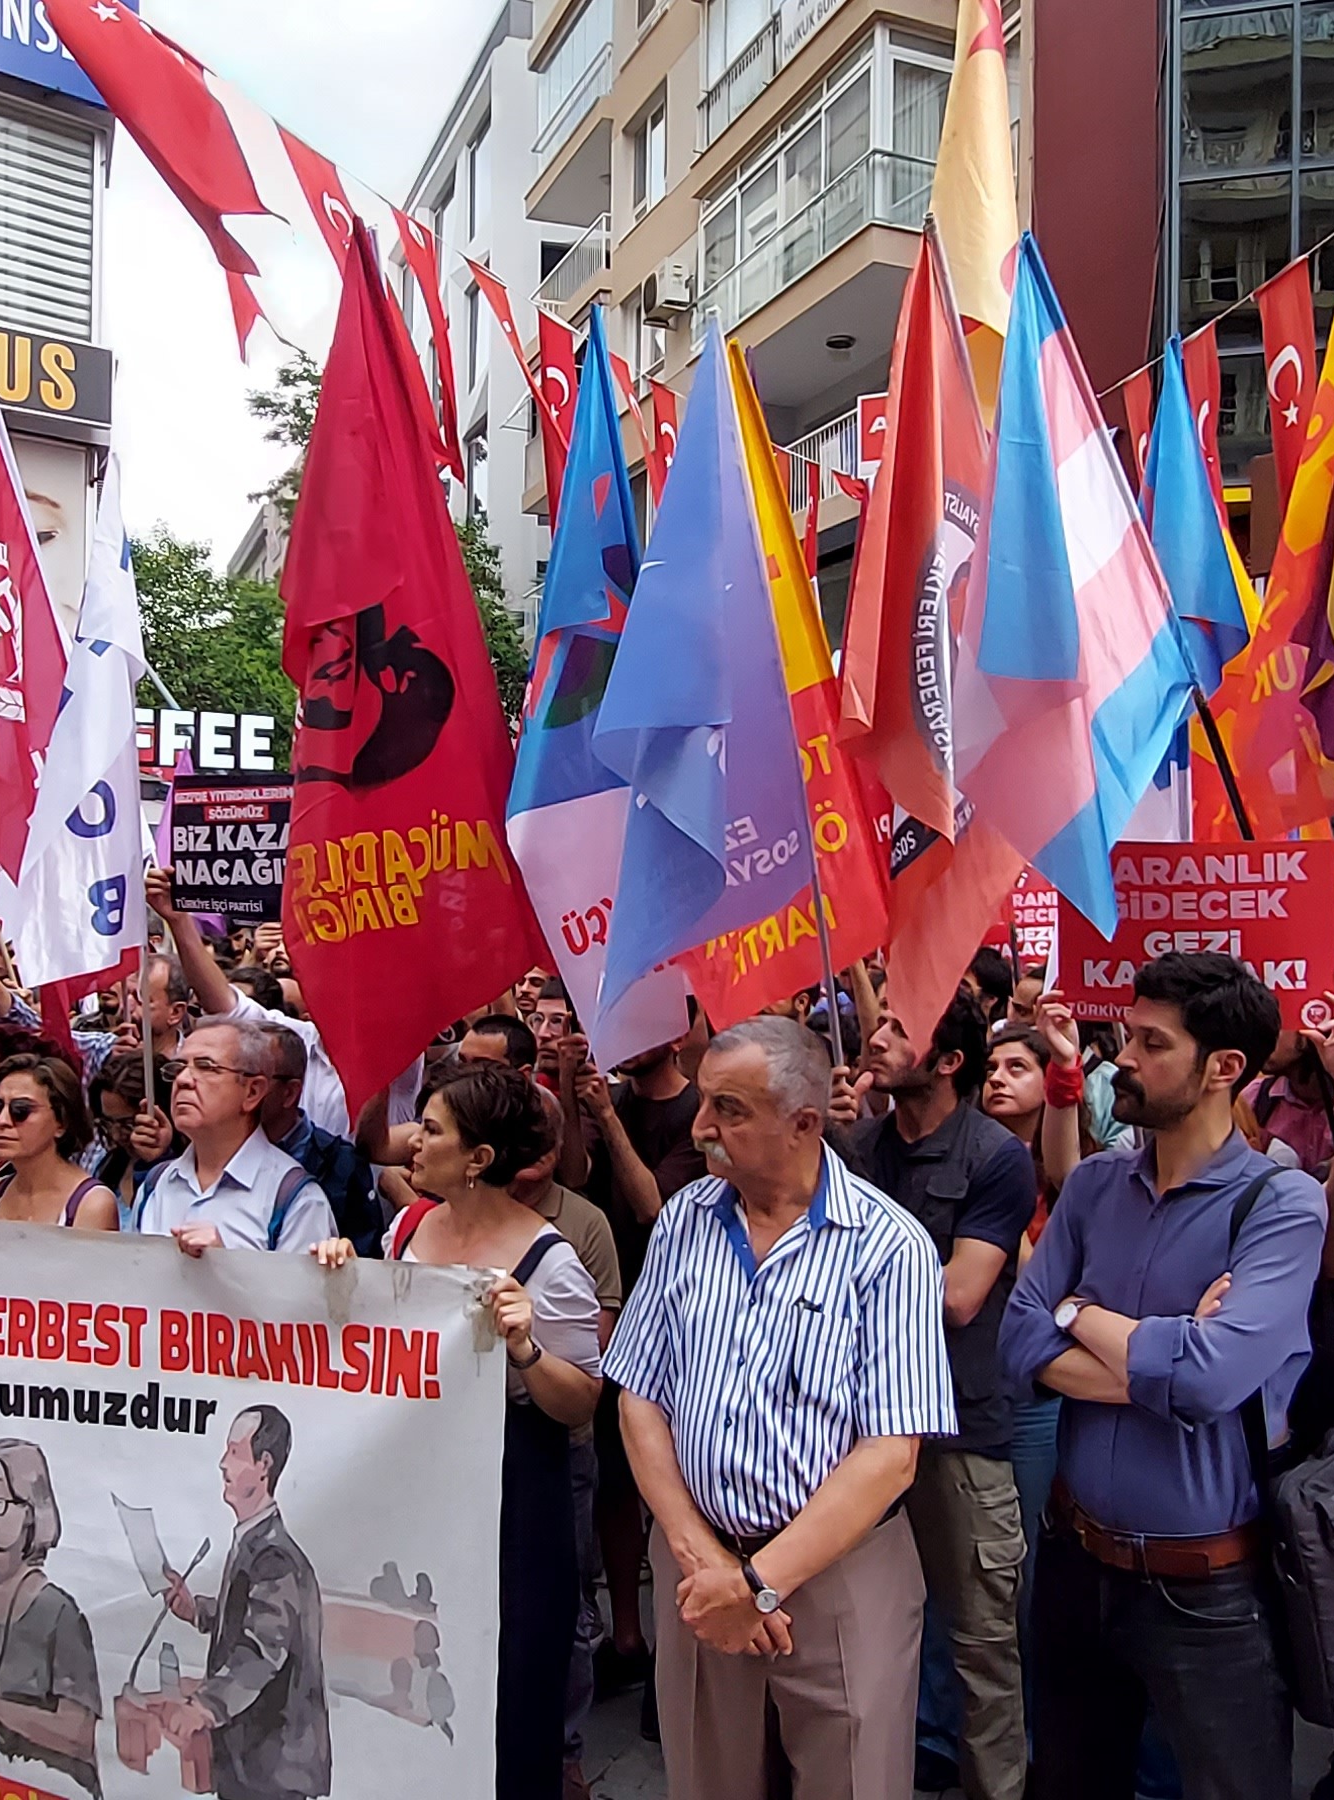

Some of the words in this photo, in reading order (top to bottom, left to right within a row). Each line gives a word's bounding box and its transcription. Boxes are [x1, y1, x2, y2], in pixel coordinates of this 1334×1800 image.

[173, 824, 212, 852] BİZ
[175, 851, 286, 886] NACAĞI
[1114, 851, 1308, 886] ARANLIK
[1115, 888, 1289, 921] GİDECEK
[1143, 929, 1242, 958] GEZİ
[159, 1308, 443, 1400] BIRAKILSIN!
